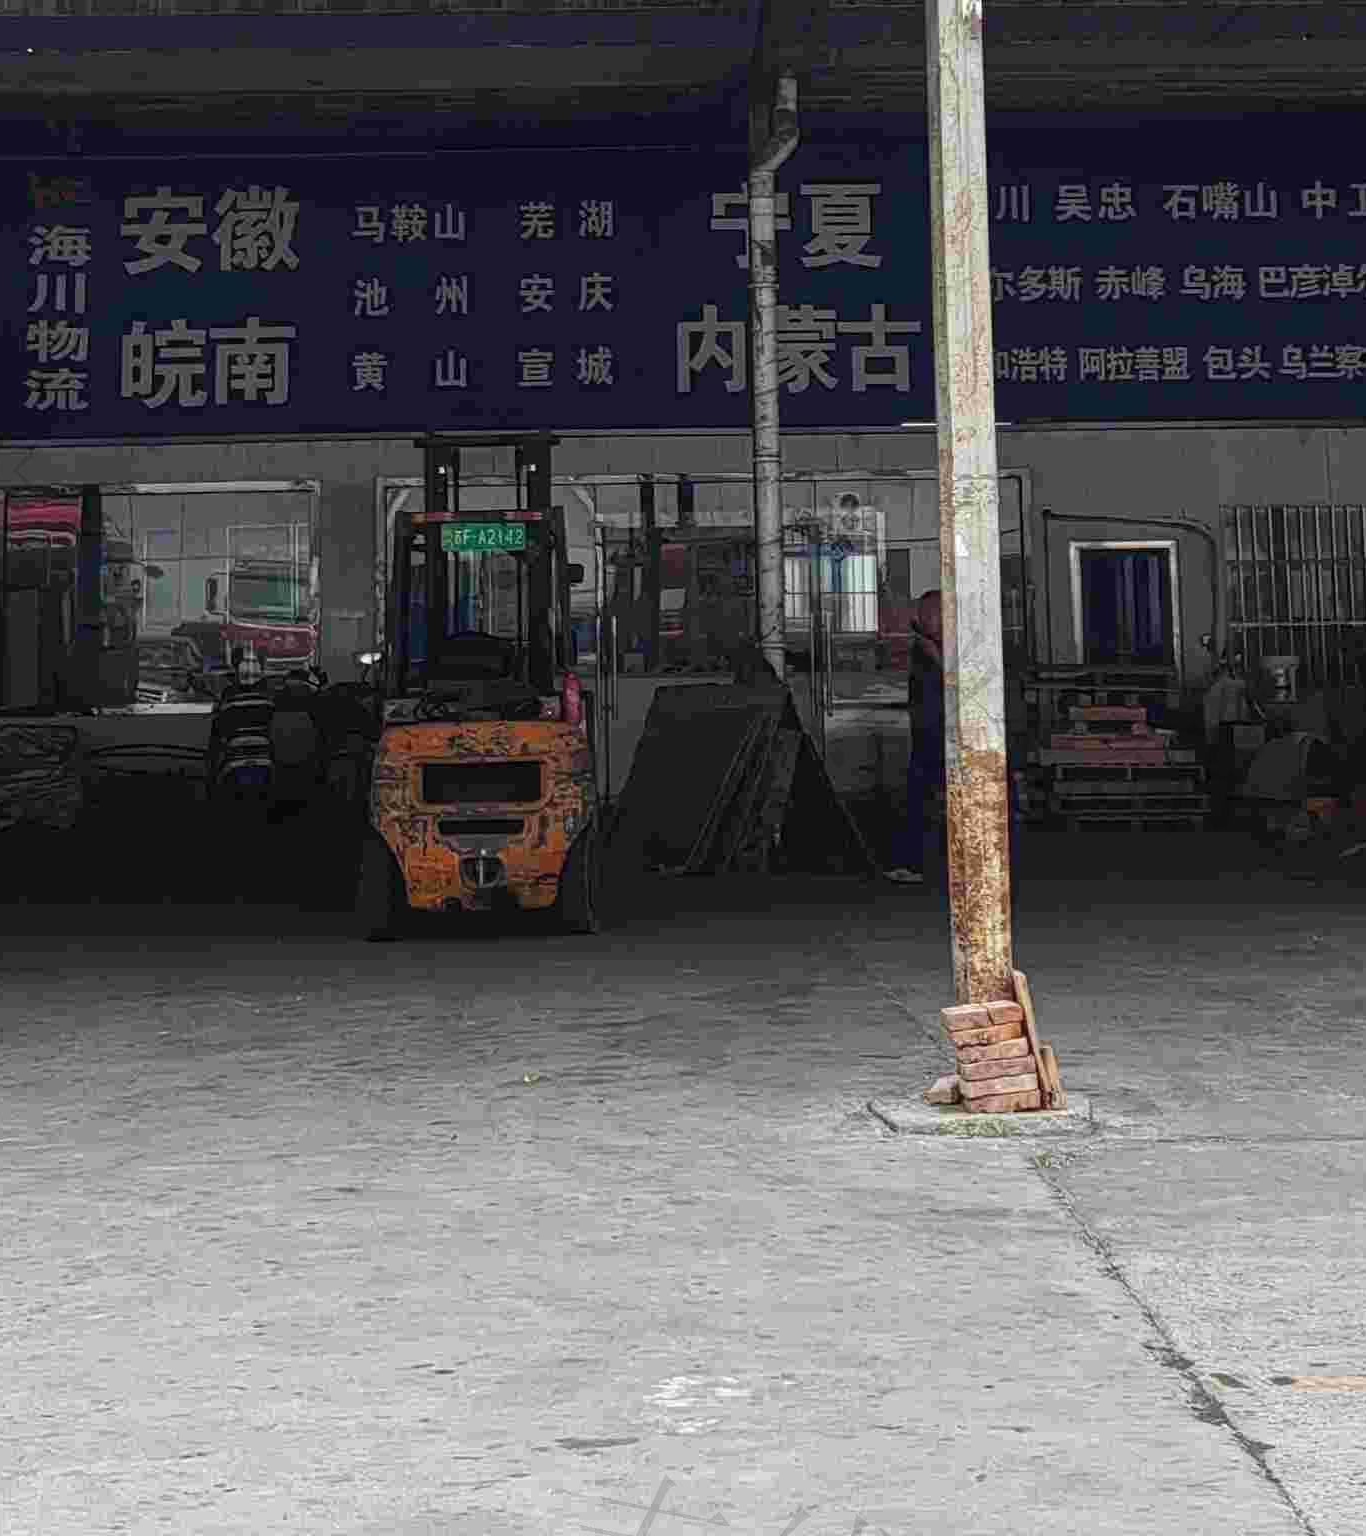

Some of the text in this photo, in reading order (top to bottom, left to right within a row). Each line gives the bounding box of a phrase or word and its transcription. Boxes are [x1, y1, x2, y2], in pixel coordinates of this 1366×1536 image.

[353, 200, 616, 242] 马鞍山 芜湖
[1053, 179, 1138, 223] 吴忠
[1160, 179, 1280, 222] 石嘴山
[119, 186, 300, 274] 安徽
[519, 273, 615, 314] 安庆
[1094, 264, 1168, 303] 赤峰
[1179, 264, 1248, 302] 乌海
[25, 223, 92, 411] 海川物流
[121, 316, 297, 408] 皖南
[517, 347, 615, 388] 宣城
[676, 304, 922, 394] 内蒙古
[1077, 344, 1191, 384] 阿拉善盟
[1203, 344, 1273, 382] 包头
